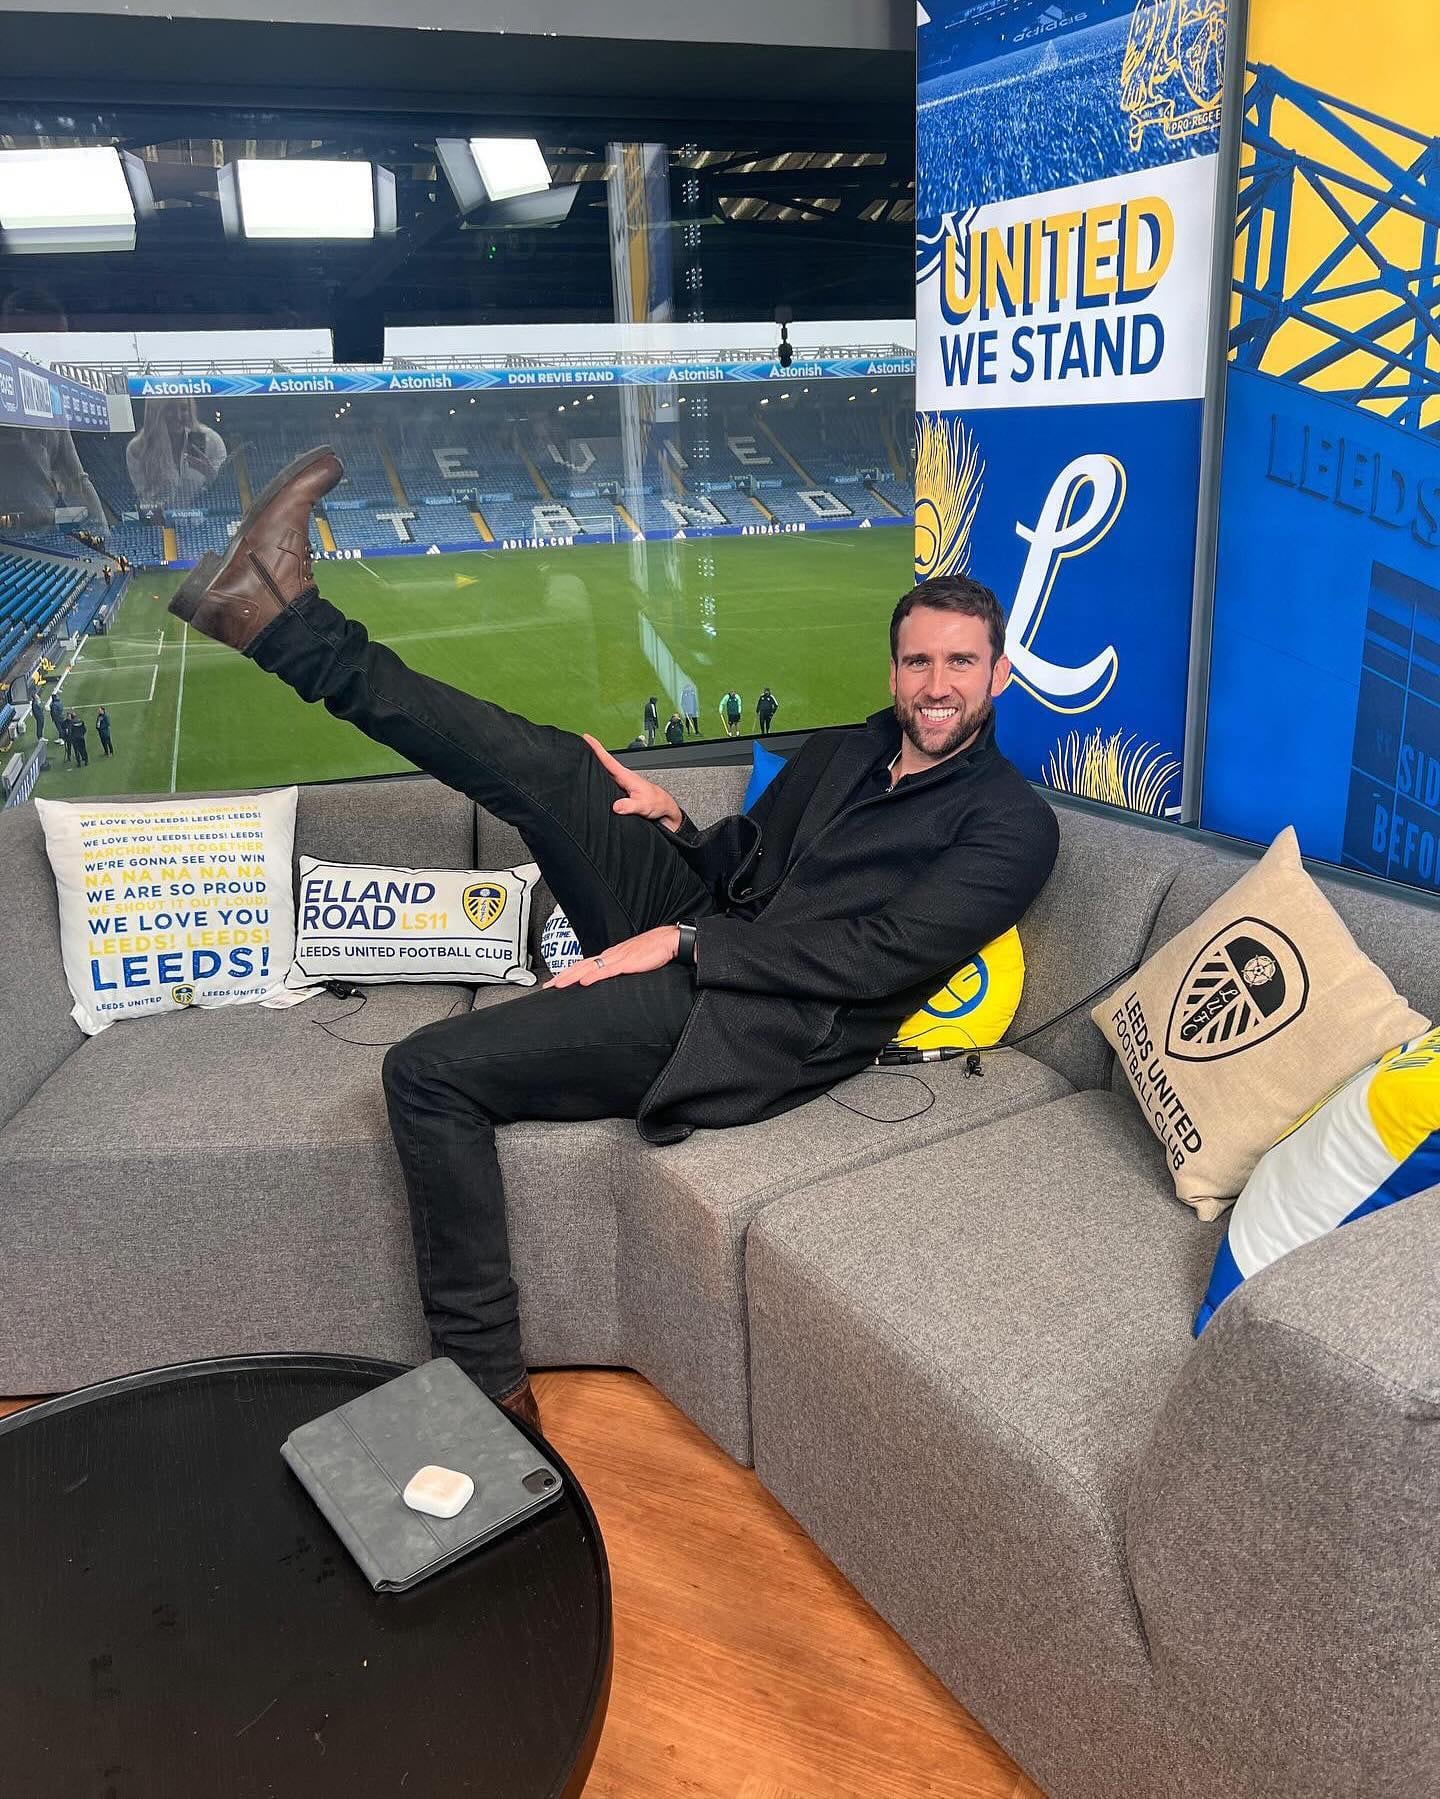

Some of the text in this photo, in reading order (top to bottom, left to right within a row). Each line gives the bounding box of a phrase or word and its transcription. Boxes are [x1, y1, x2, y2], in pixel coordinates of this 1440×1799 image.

[940, 196, 1174, 325] UNITED
[940, 313, 1165, 386] WE STAND
[509, 371, 614, 384] DON REVIE STAND
[667, 367, 724, 381] Astonish
[769, 364, 822, 378] Astonish
[142, 380, 211, 395] Astonish
[268, 377, 334, 392] Astonish
[389, 374, 452, 389] Astonish
[1266, 414, 1440, 547] LEEDS
[742, 523, 806, 535] ADIDAS.COM
[80, 820, 97, 828] WE
[192, 814, 225, 822] LEEDS!
[228, 812, 262, 820] LEEDS!
[83, 840, 98, 848] WE
[101, 836, 128, 845] LOVE
[194, 832, 228, 840] LEEDS!
[230, 831, 264, 839] LEEDS!
[161, 844, 183, 854] ON
[188, 842, 264, 852] TOGETHER
[85, 853, 265, 872] WE'RE GONNA SEE YOU WIN
[85, 864, 265, 888] NA NA NA NA NA
[86, 881, 266, 903] WE ARE SO PROUD
[305, 880, 436, 904] ELLAND
[87, 904, 109, 916] WE
[115, 900, 164, 914] SHOUT
[171, 899, 185, 909] IT
[190, 897, 219, 908] OUT
[88, 909, 269, 935] WE LOVE YOU
[303, 905, 448, 931] ROAD LS11
[87, 928, 270, 956] LEEDS! LEEDS!
[301, 946, 513, 960] LEEDS UNITED FOOTBALL CLUB
[91, 947, 269, 991] LEEDS!
[202, 988, 267, 997] LEEDS UNITED
[96, 996, 162, 1012] LEEDS UNITED
[1125, 991, 1203, 1154] LEEDS UNITED
[1112, 1008, 1186, 1171] FOOTBALL CLUB
